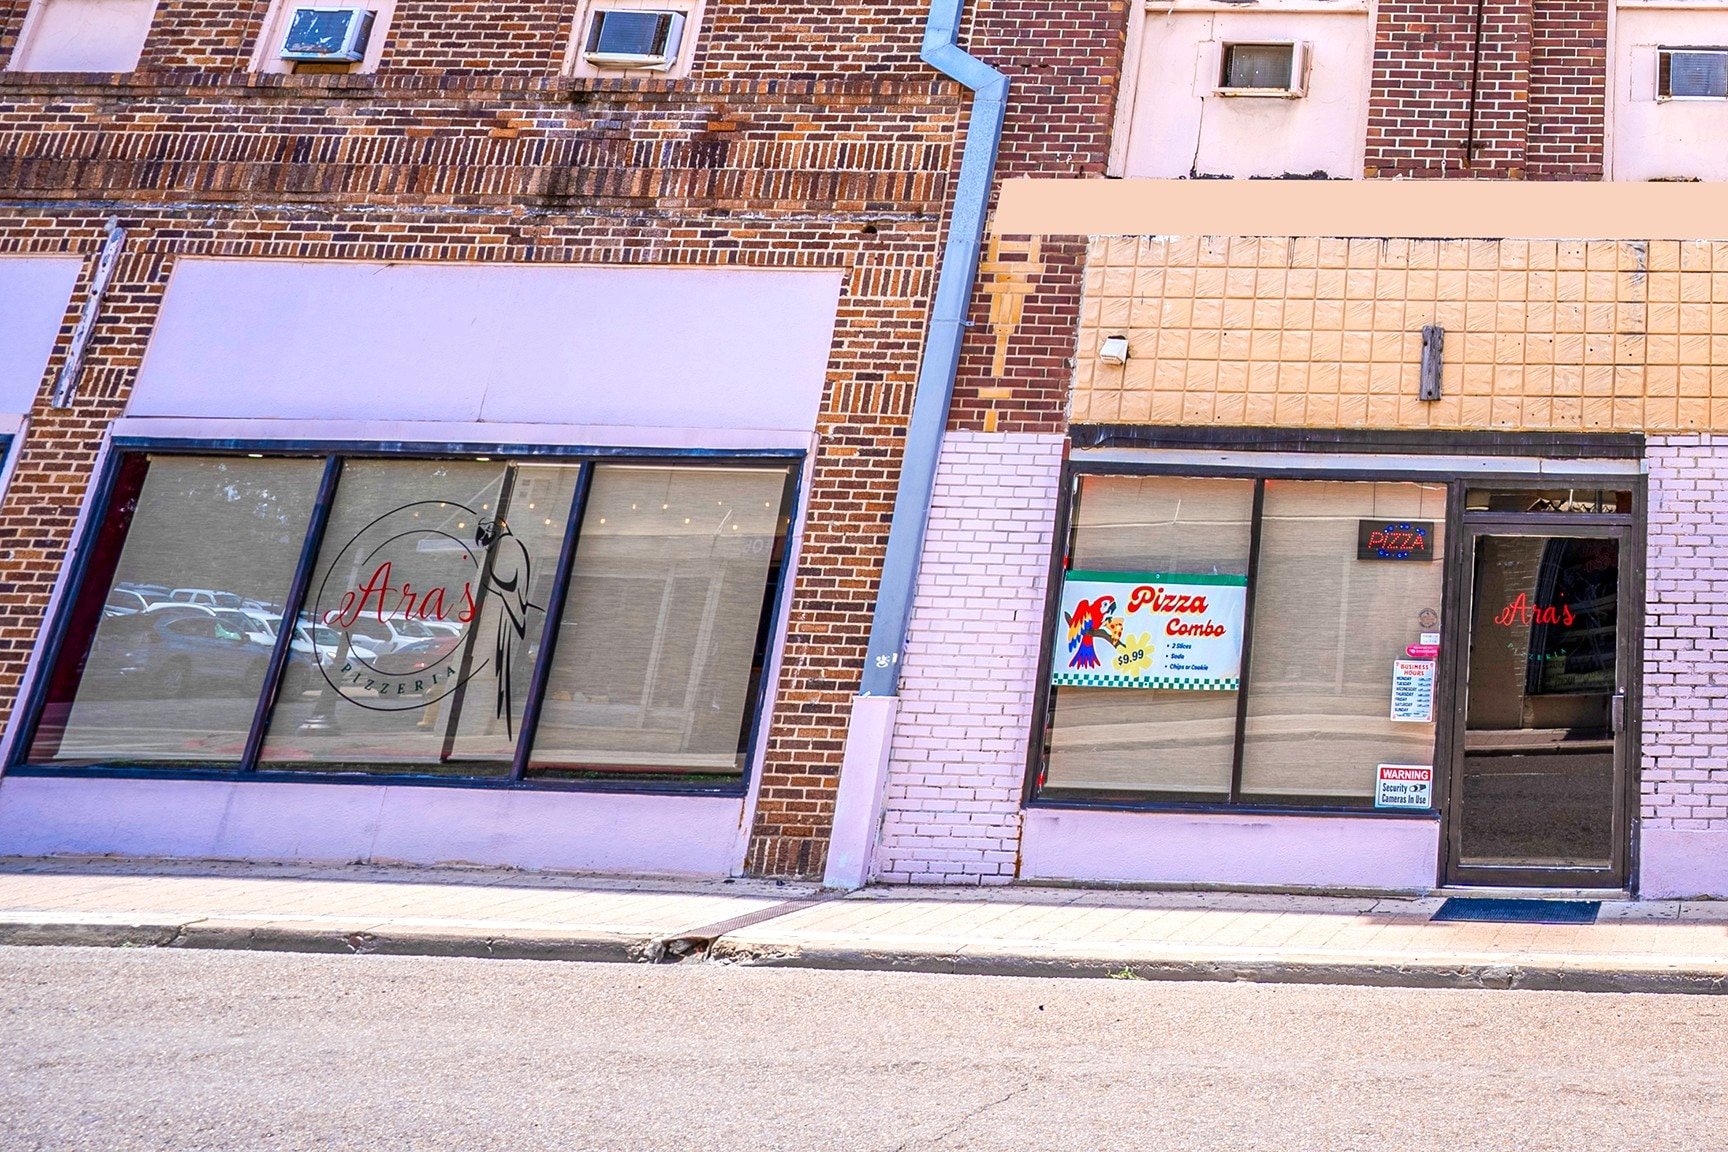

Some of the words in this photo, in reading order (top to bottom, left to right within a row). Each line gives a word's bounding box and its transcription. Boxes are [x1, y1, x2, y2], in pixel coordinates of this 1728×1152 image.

[1368, 531, 1425, 550] PIZZA
[1127, 585, 1210, 614] Pizza
[1166, 618, 1227, 638] Combo
[1118, 649, 1144, 666] $9.99
[341, 663, 456, 694] PIZZERIA
[1382, 769, 1429, 780] WARNING
[1382, 782, 1408, 794] Security
[1382, 793, 1407, 804] Cameras
[1407, 794, 1415, 804] In
[1415, 794, 1427, 804] Use
